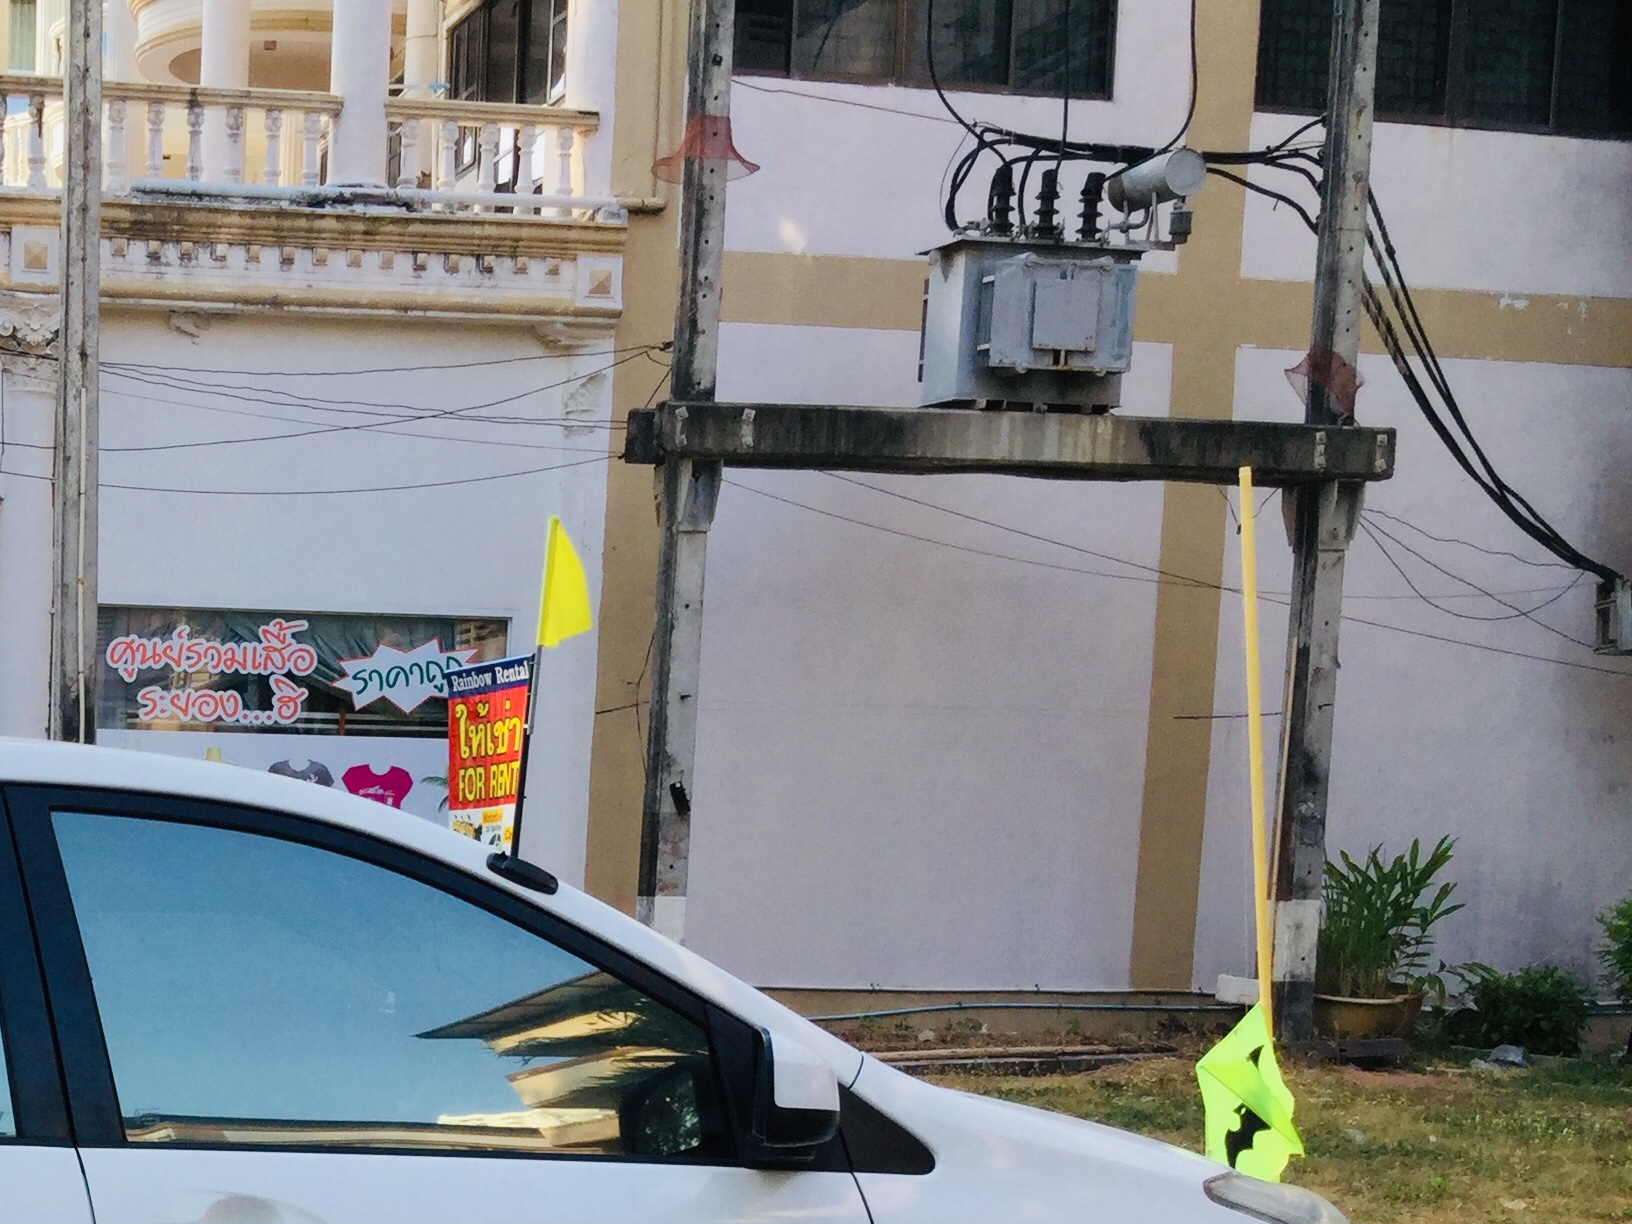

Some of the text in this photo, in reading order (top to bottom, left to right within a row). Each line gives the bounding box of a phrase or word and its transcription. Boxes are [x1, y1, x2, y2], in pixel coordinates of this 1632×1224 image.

[108, 619, 316, 680] ศูนย์รวมเสื้อ
[451, 660, 529, 692] Rainbow Rental
[455, 698, 521, 760] ให้เช่า
[458, 760, 520, 802] FOR RENT
